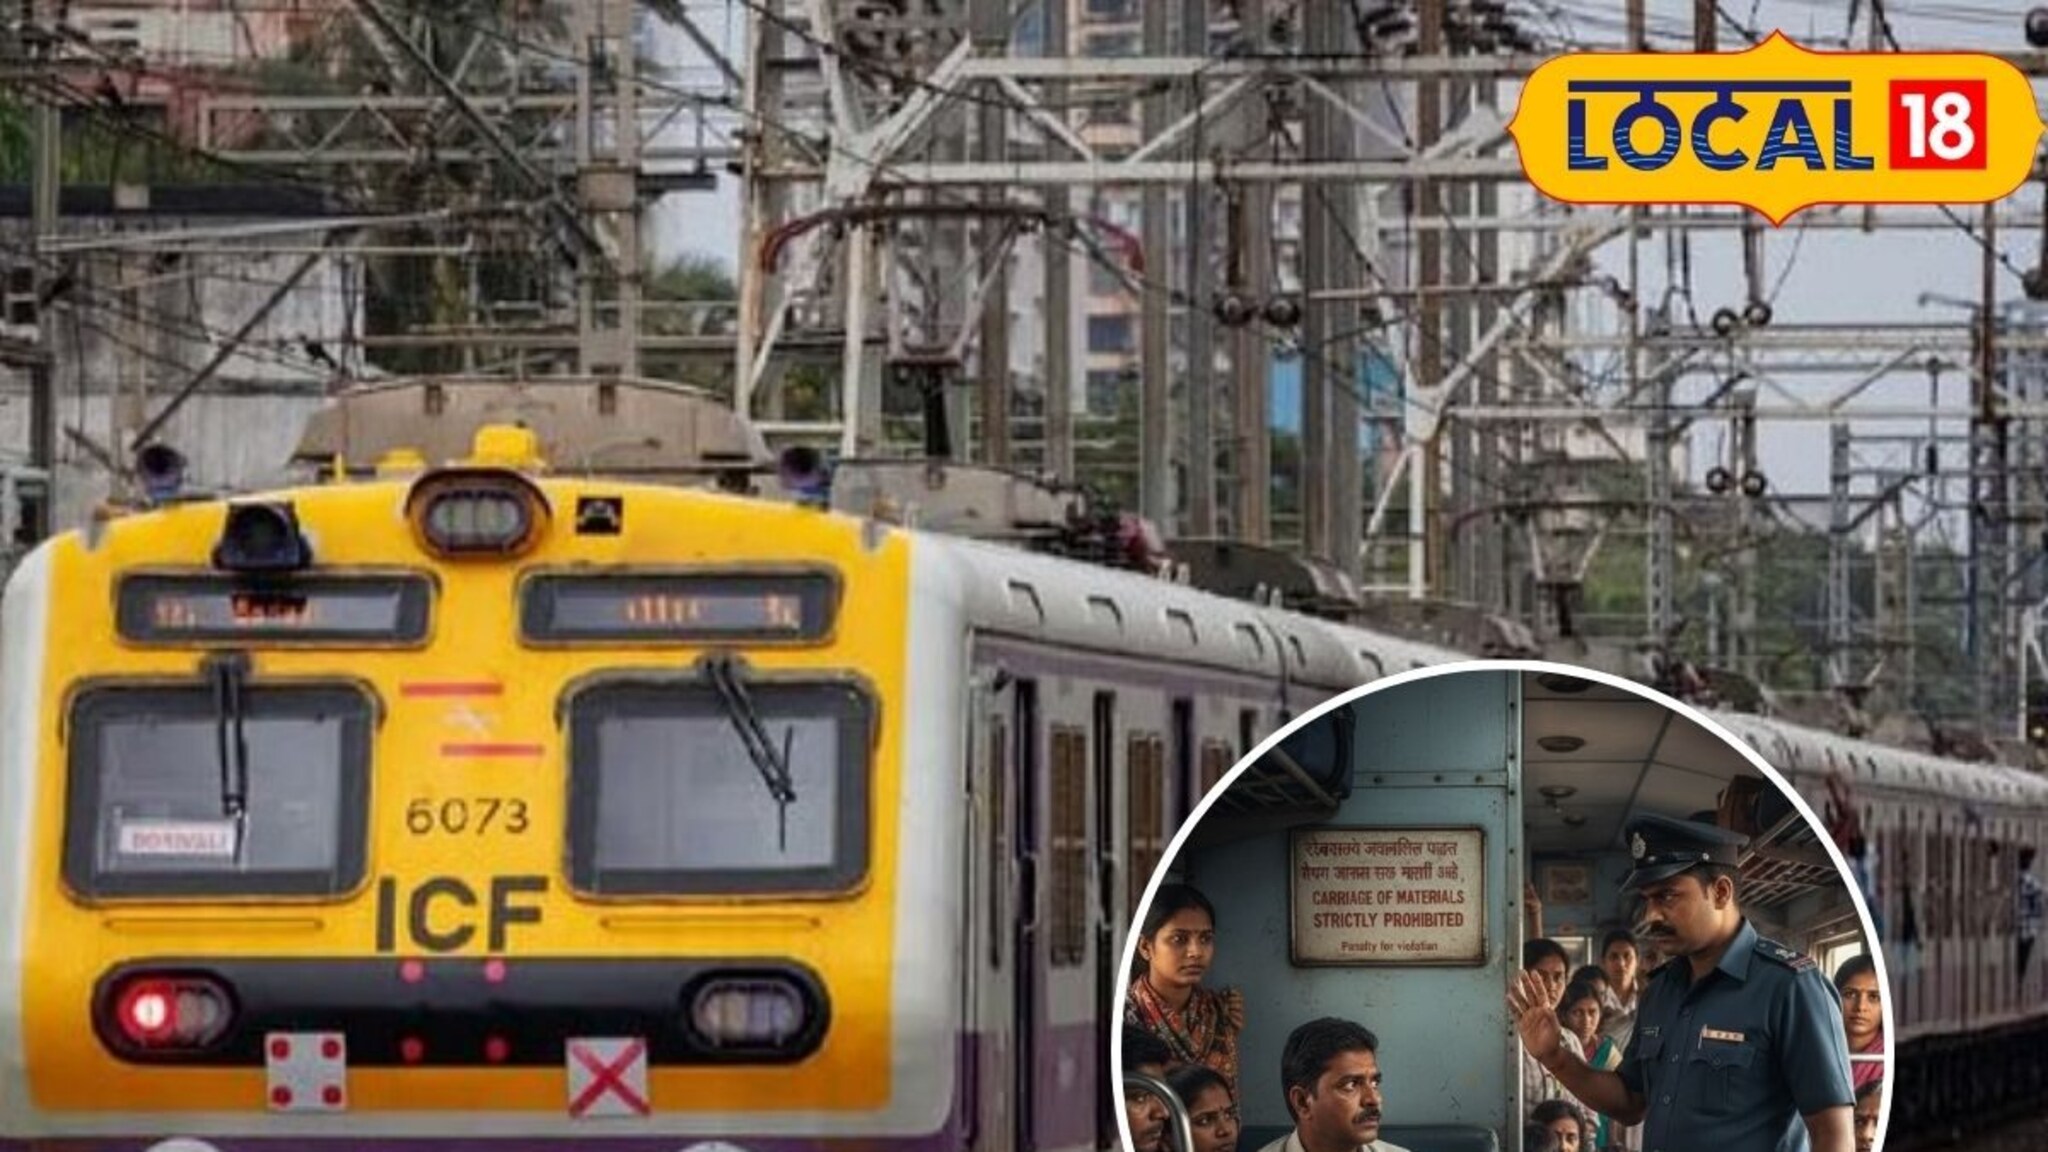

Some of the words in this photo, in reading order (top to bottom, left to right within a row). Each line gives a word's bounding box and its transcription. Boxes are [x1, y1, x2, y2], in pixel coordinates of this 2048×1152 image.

[406, 799, 530, 836] 6073
[1312, 890, 1373, 905] CARRIAGE
[1377, 890, 1394, 905] OF
[1397, 889, 1465, 905] MATERIALS
[375, 875, 549, 953] ICF
[1313, 913, 1378, 928] STRICTLY
[1384, 912, 1464, 928] PROHIBITED
[1380, 941, 1394, 951] for
